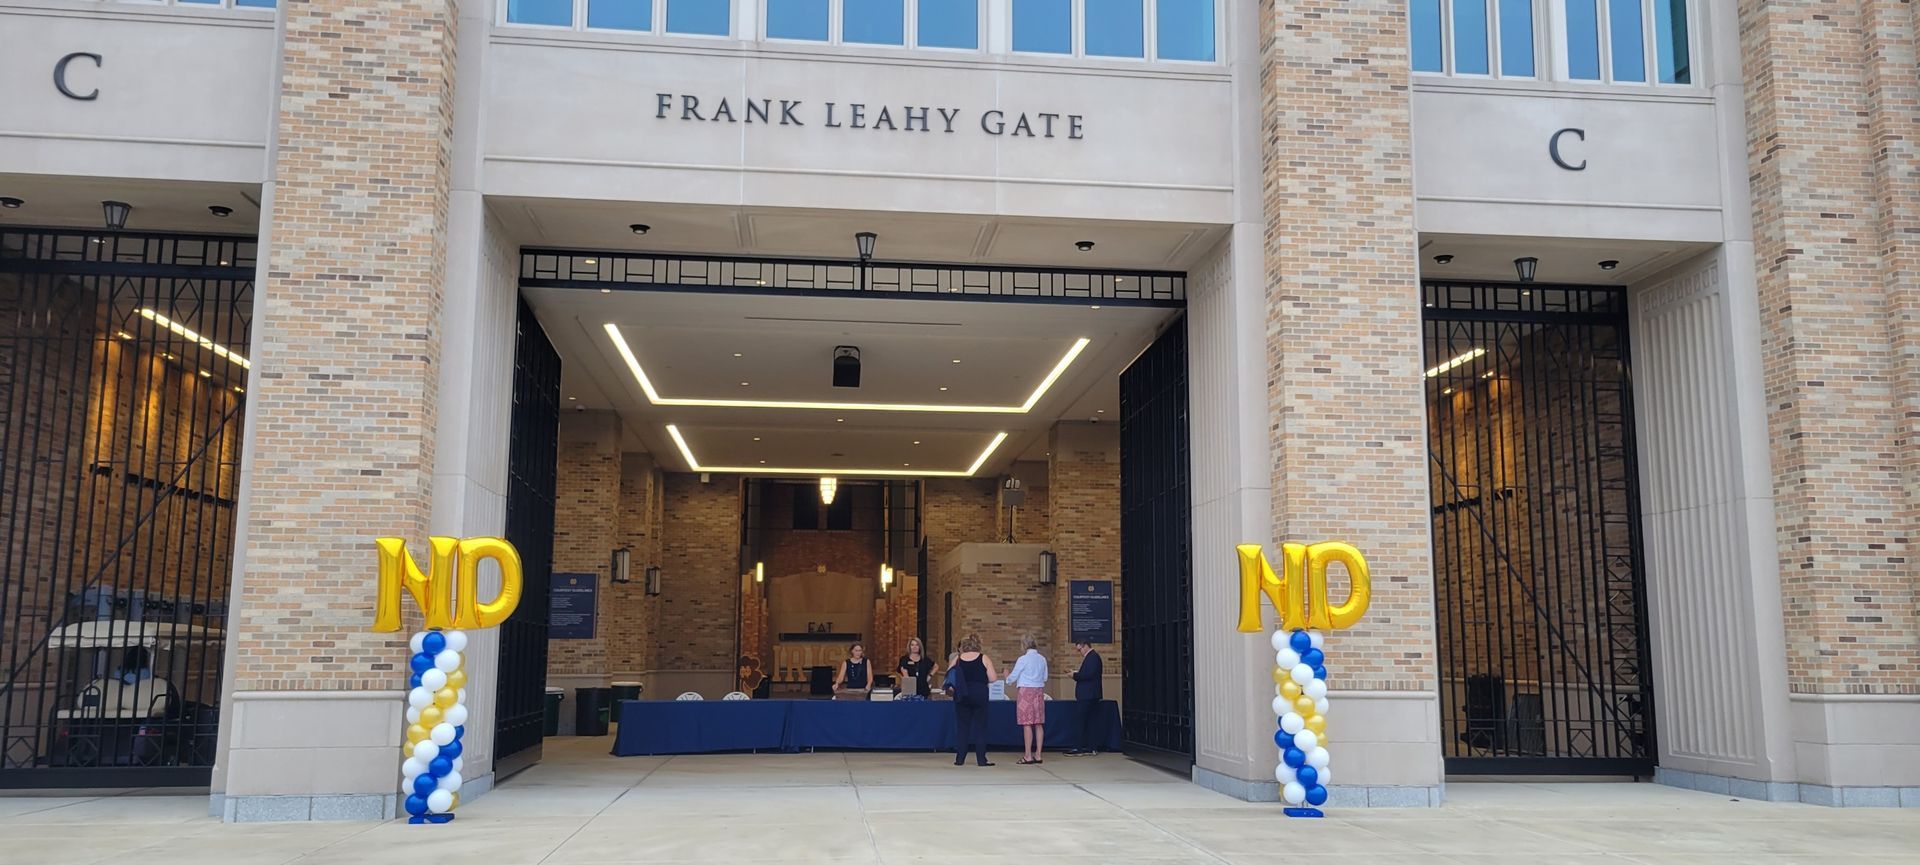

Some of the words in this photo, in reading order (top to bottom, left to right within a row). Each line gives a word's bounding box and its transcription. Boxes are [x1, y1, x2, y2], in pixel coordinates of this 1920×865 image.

[53, 52, 103, 102] C
[655, 92, 805, 127] FRANK
[824, 102, 961, 134] LEAHY
[980, 110, 1084, 140] GATE
[1548, 127, 1588, 172] C
[373, 535, 523, 632] ND
[1236, 540, 1372, 633] ND
[807, 621, 834, 633] EAT
[771, 645, 865, 682] IRIS
